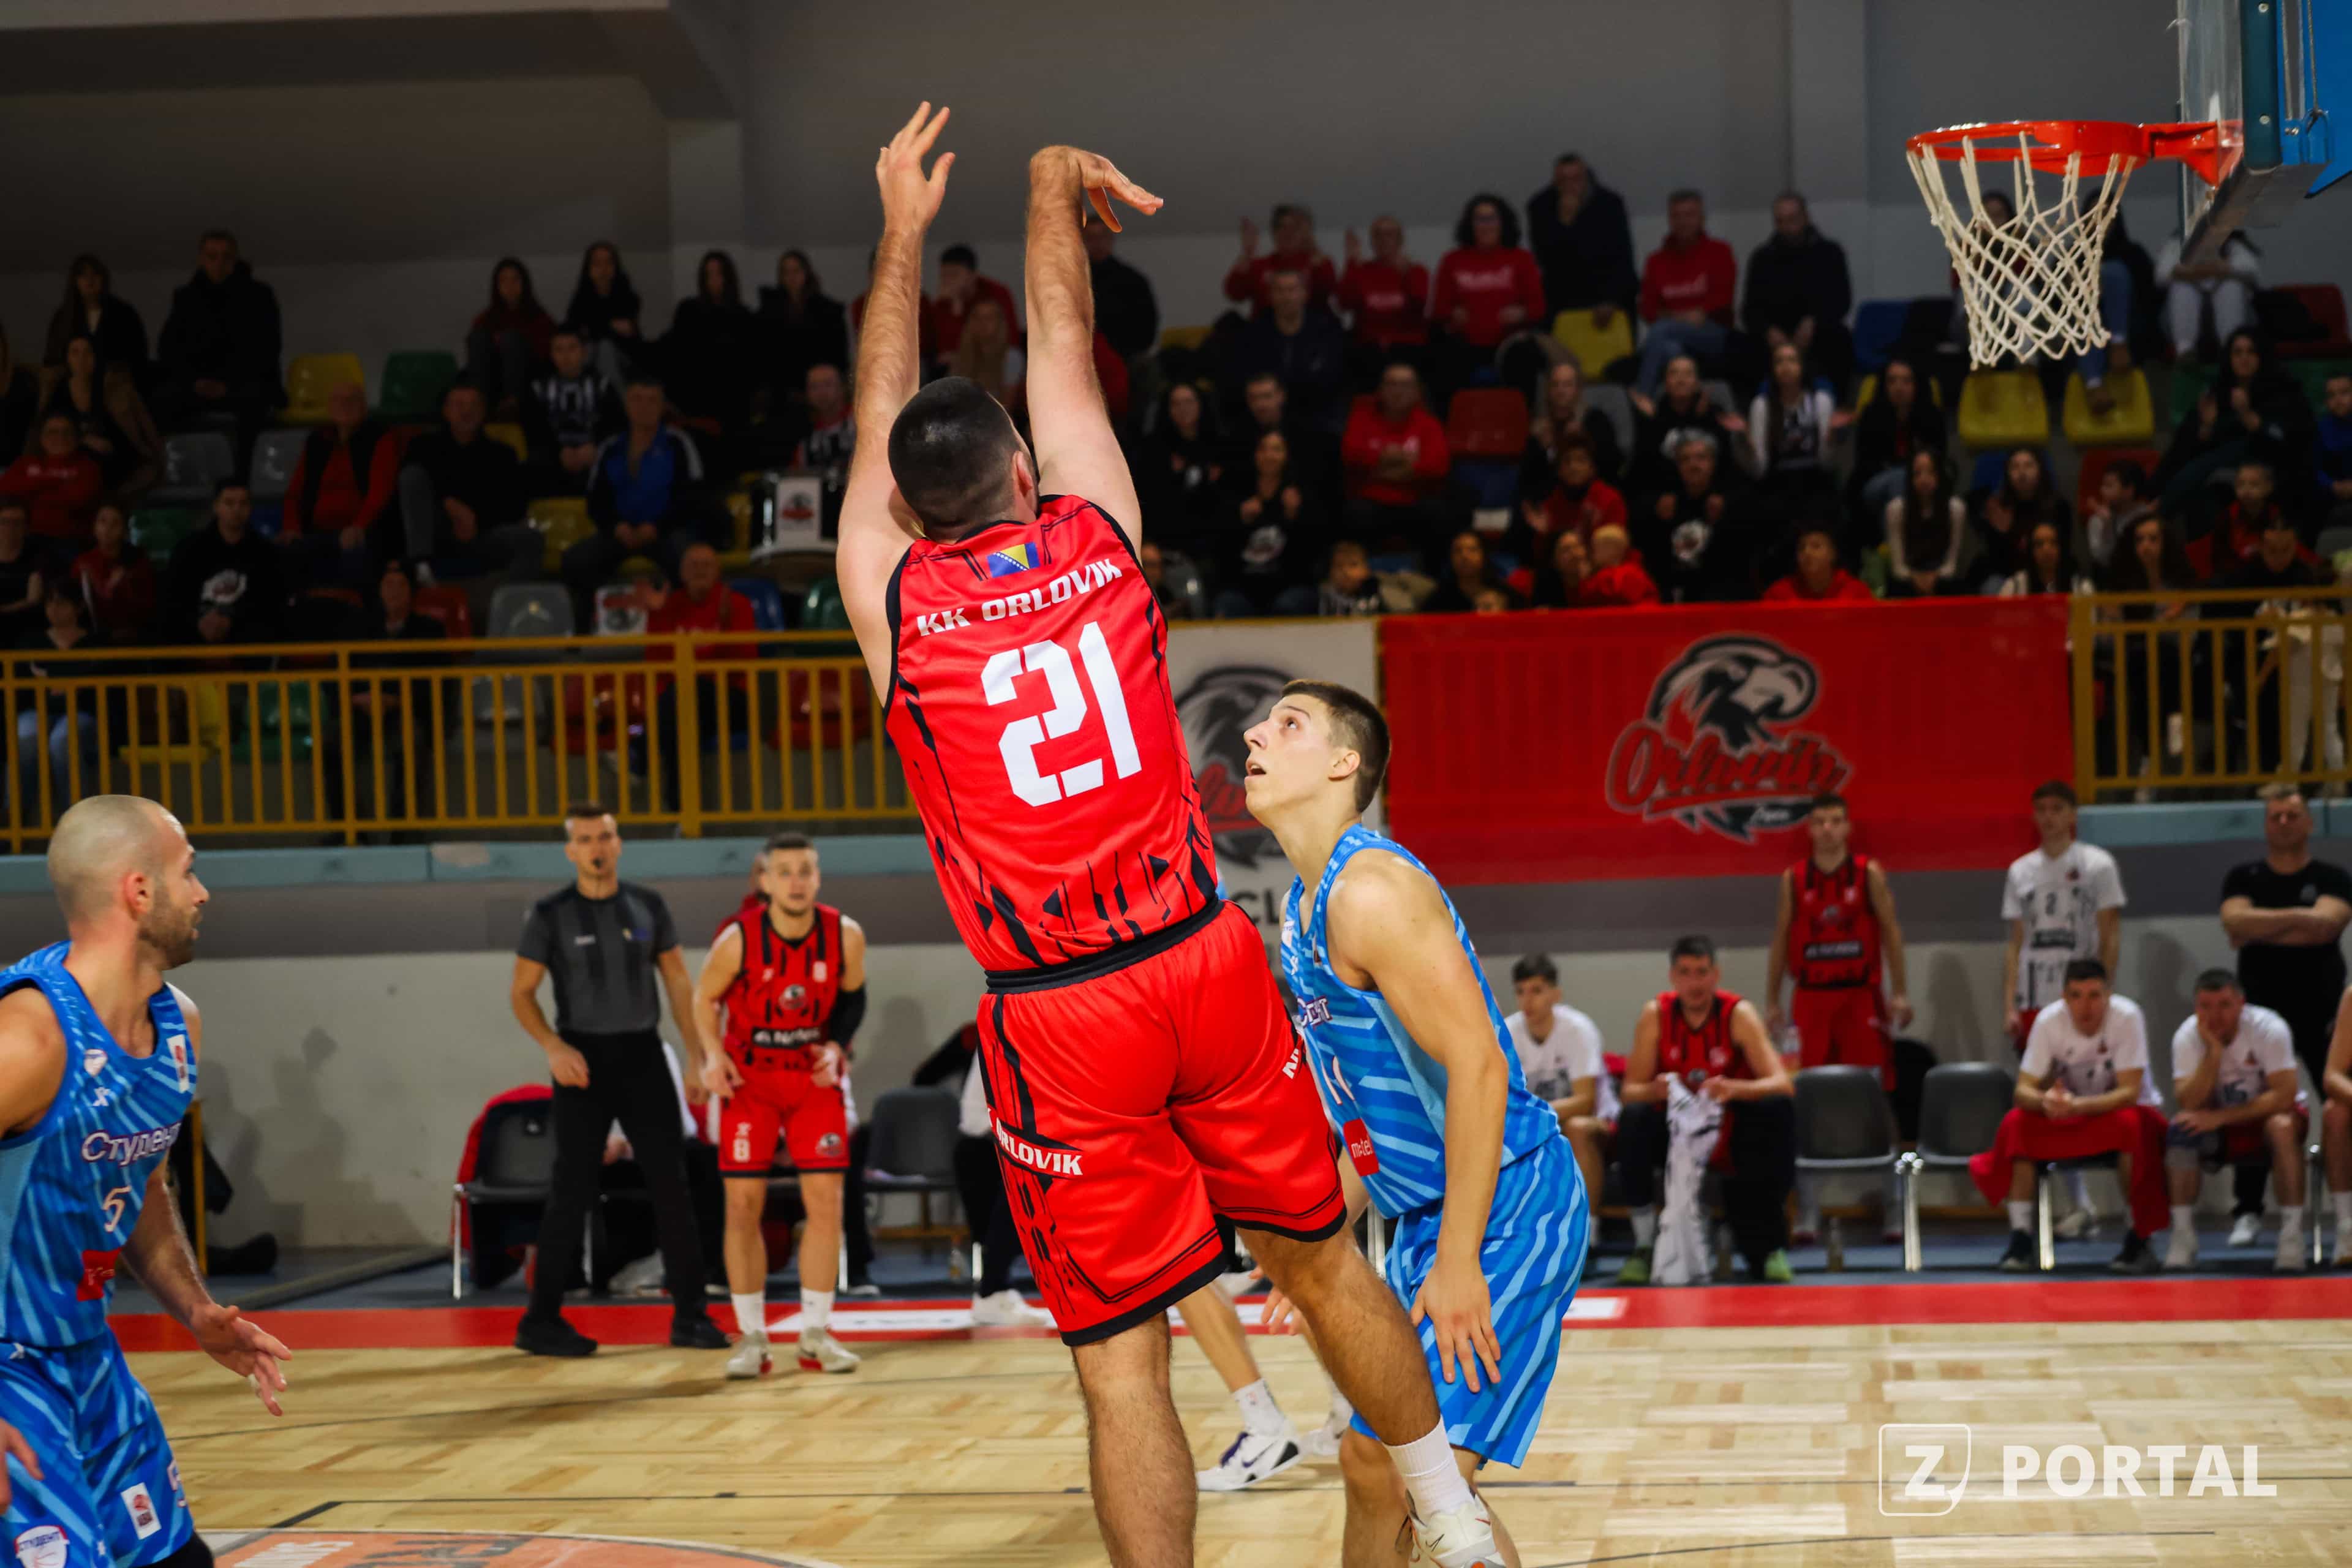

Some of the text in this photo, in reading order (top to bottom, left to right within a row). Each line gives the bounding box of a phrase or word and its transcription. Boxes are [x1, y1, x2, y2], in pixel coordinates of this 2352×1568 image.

[917, 559, 1123, 637] KK ORLOVIK
[981, 620, 1142, 807] 21
